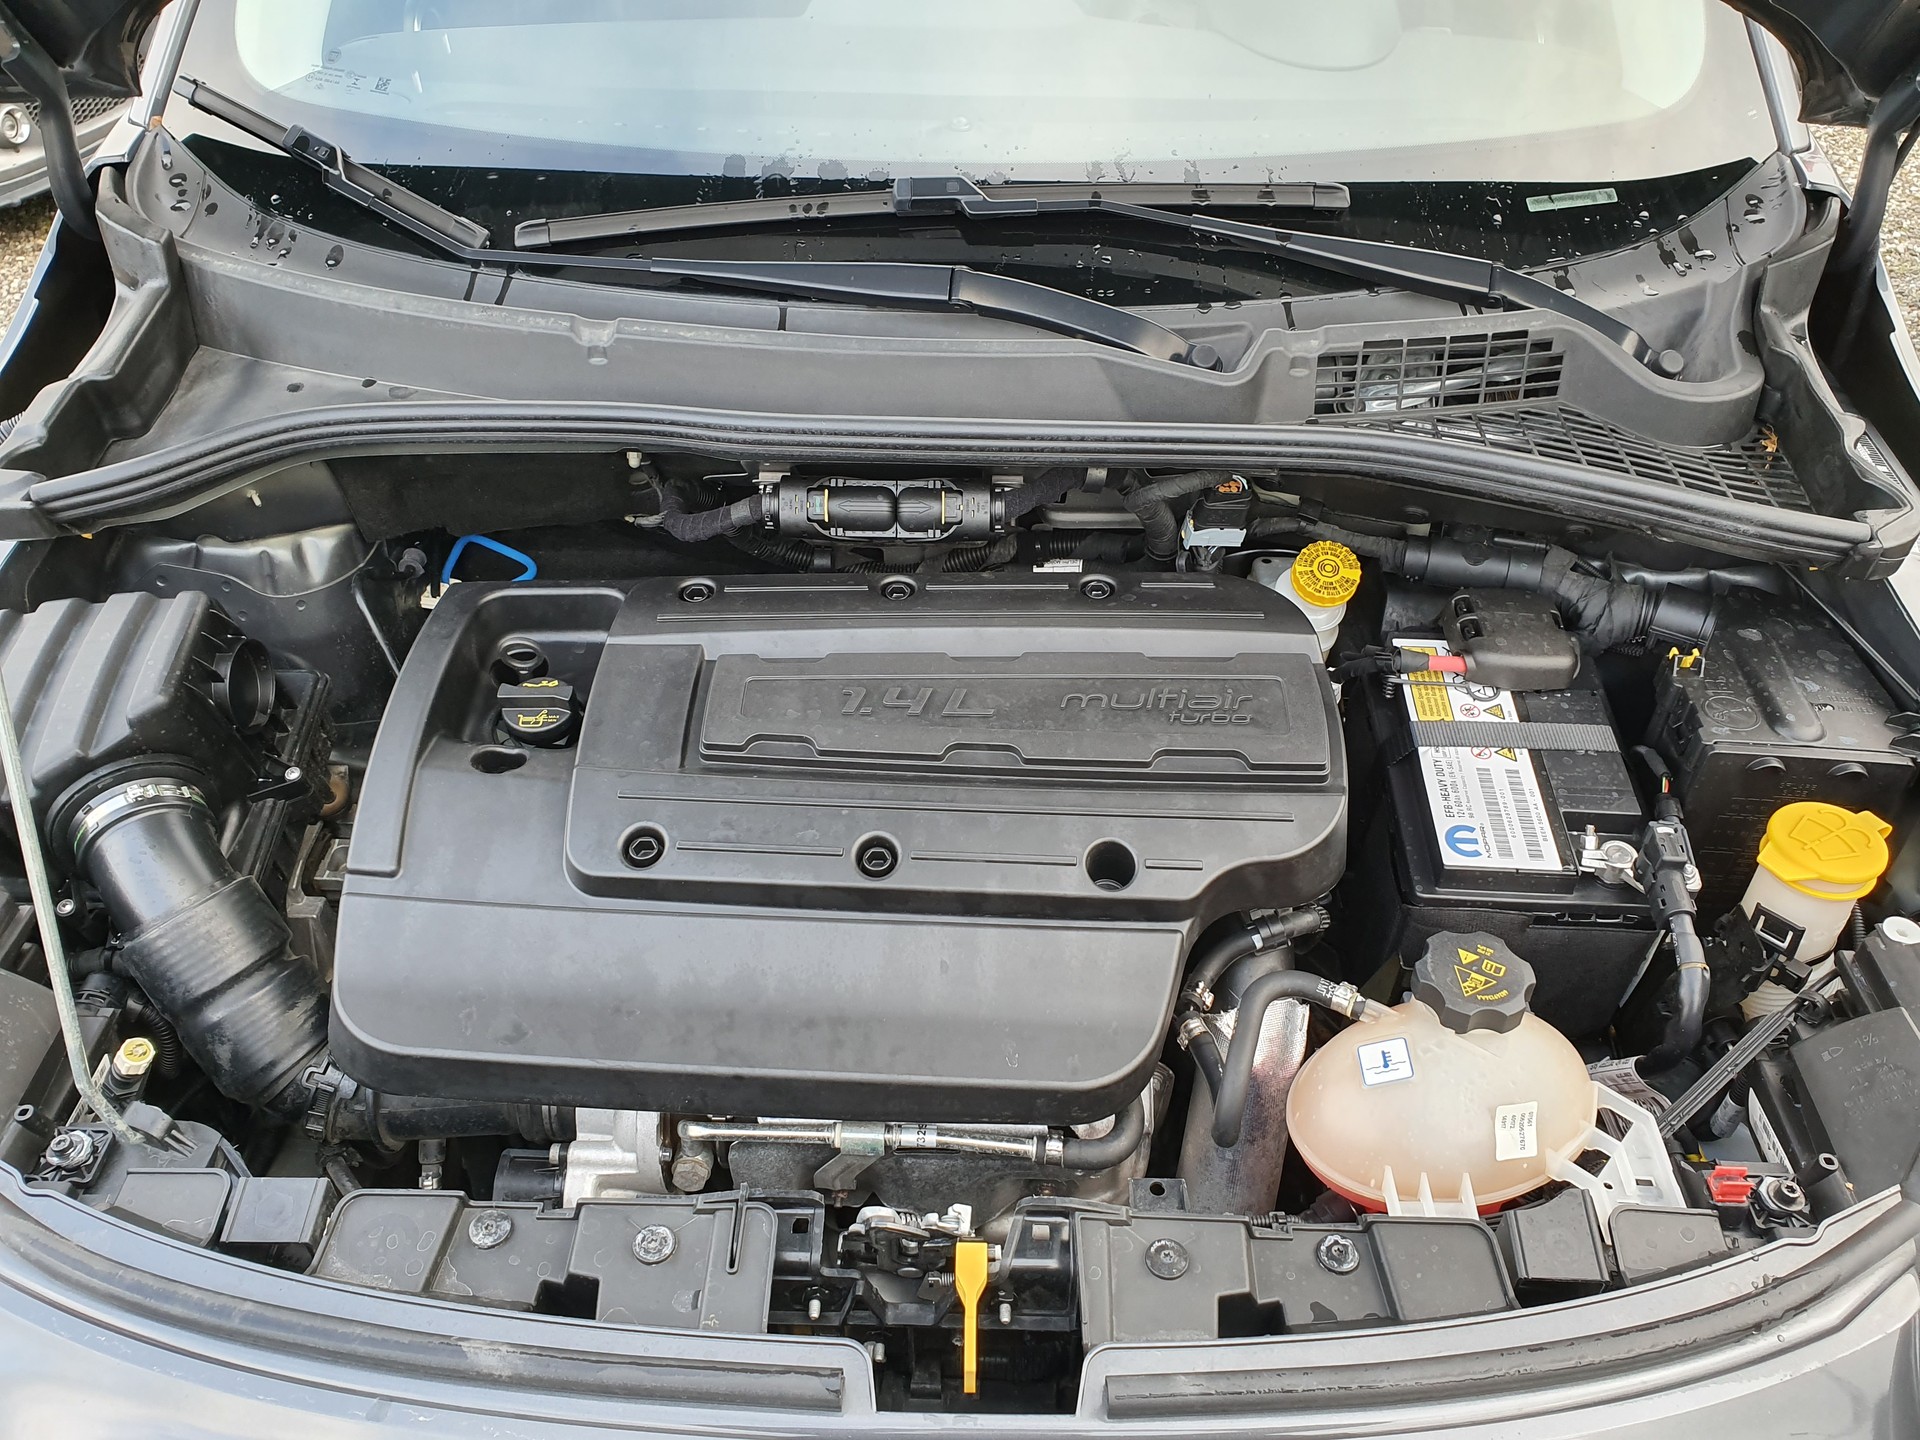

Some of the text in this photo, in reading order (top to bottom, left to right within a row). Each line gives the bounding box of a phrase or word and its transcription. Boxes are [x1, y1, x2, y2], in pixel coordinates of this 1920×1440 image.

[1060, 687, 1253, 710] multiair
[1168, 712, 1253, 726] turbo
[1432, 759, 1455, 818] EFB-HEAVY DUTY
